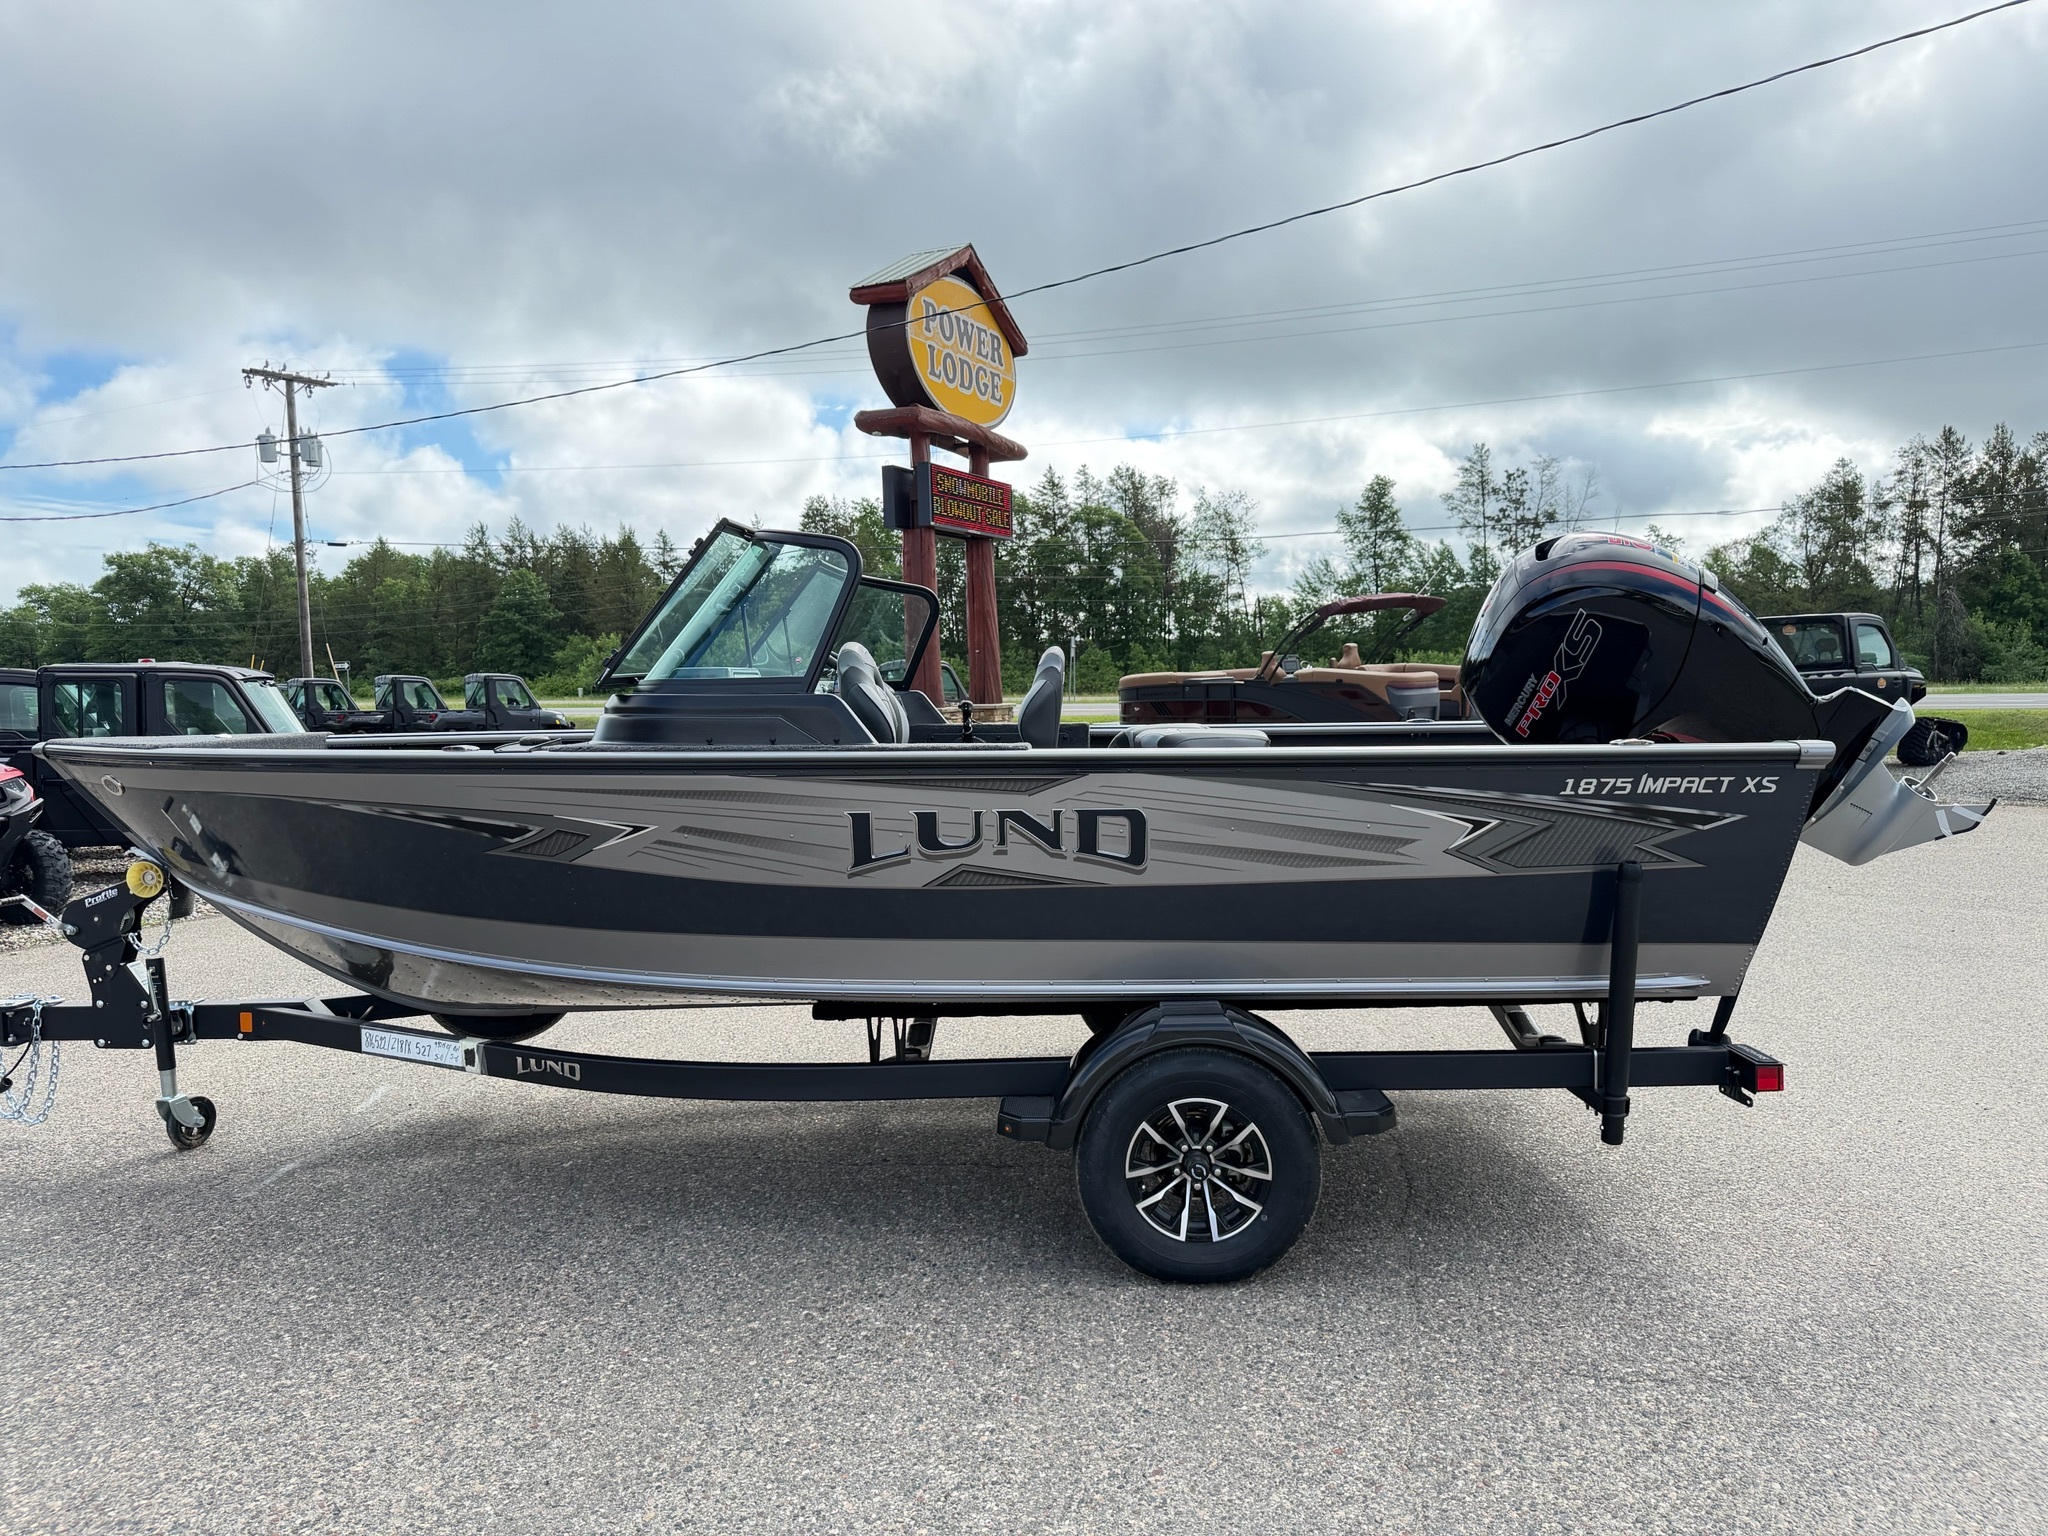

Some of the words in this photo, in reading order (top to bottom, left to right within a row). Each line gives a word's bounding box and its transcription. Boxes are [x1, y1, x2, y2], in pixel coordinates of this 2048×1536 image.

[922, 298, 1004, 368] POWER
[927, 344, 1003, 404] LODGE
[936, 473, 1004, 505] SNOWMOBILE
[932, 496, 983, 523] BLOWOUT
[985, 508, 1009, 528] SALE
[1516, 670, 1561, 738] PRO
[1553, 607, 1602, 711] XS
[1504, 672, 1538, 727] MERCURY
[1559, 778, 1634, 795] 1875
[1635, 773, 1736, 794] IMPACT
[1740, 776, 1780, 794] XS
[843, 808, 1148, 874] LUND
[84, 888, 118, 906] Profile
[415, 1042, 432, 1057] 527
[515, 1056, 581, 1081] LUND
